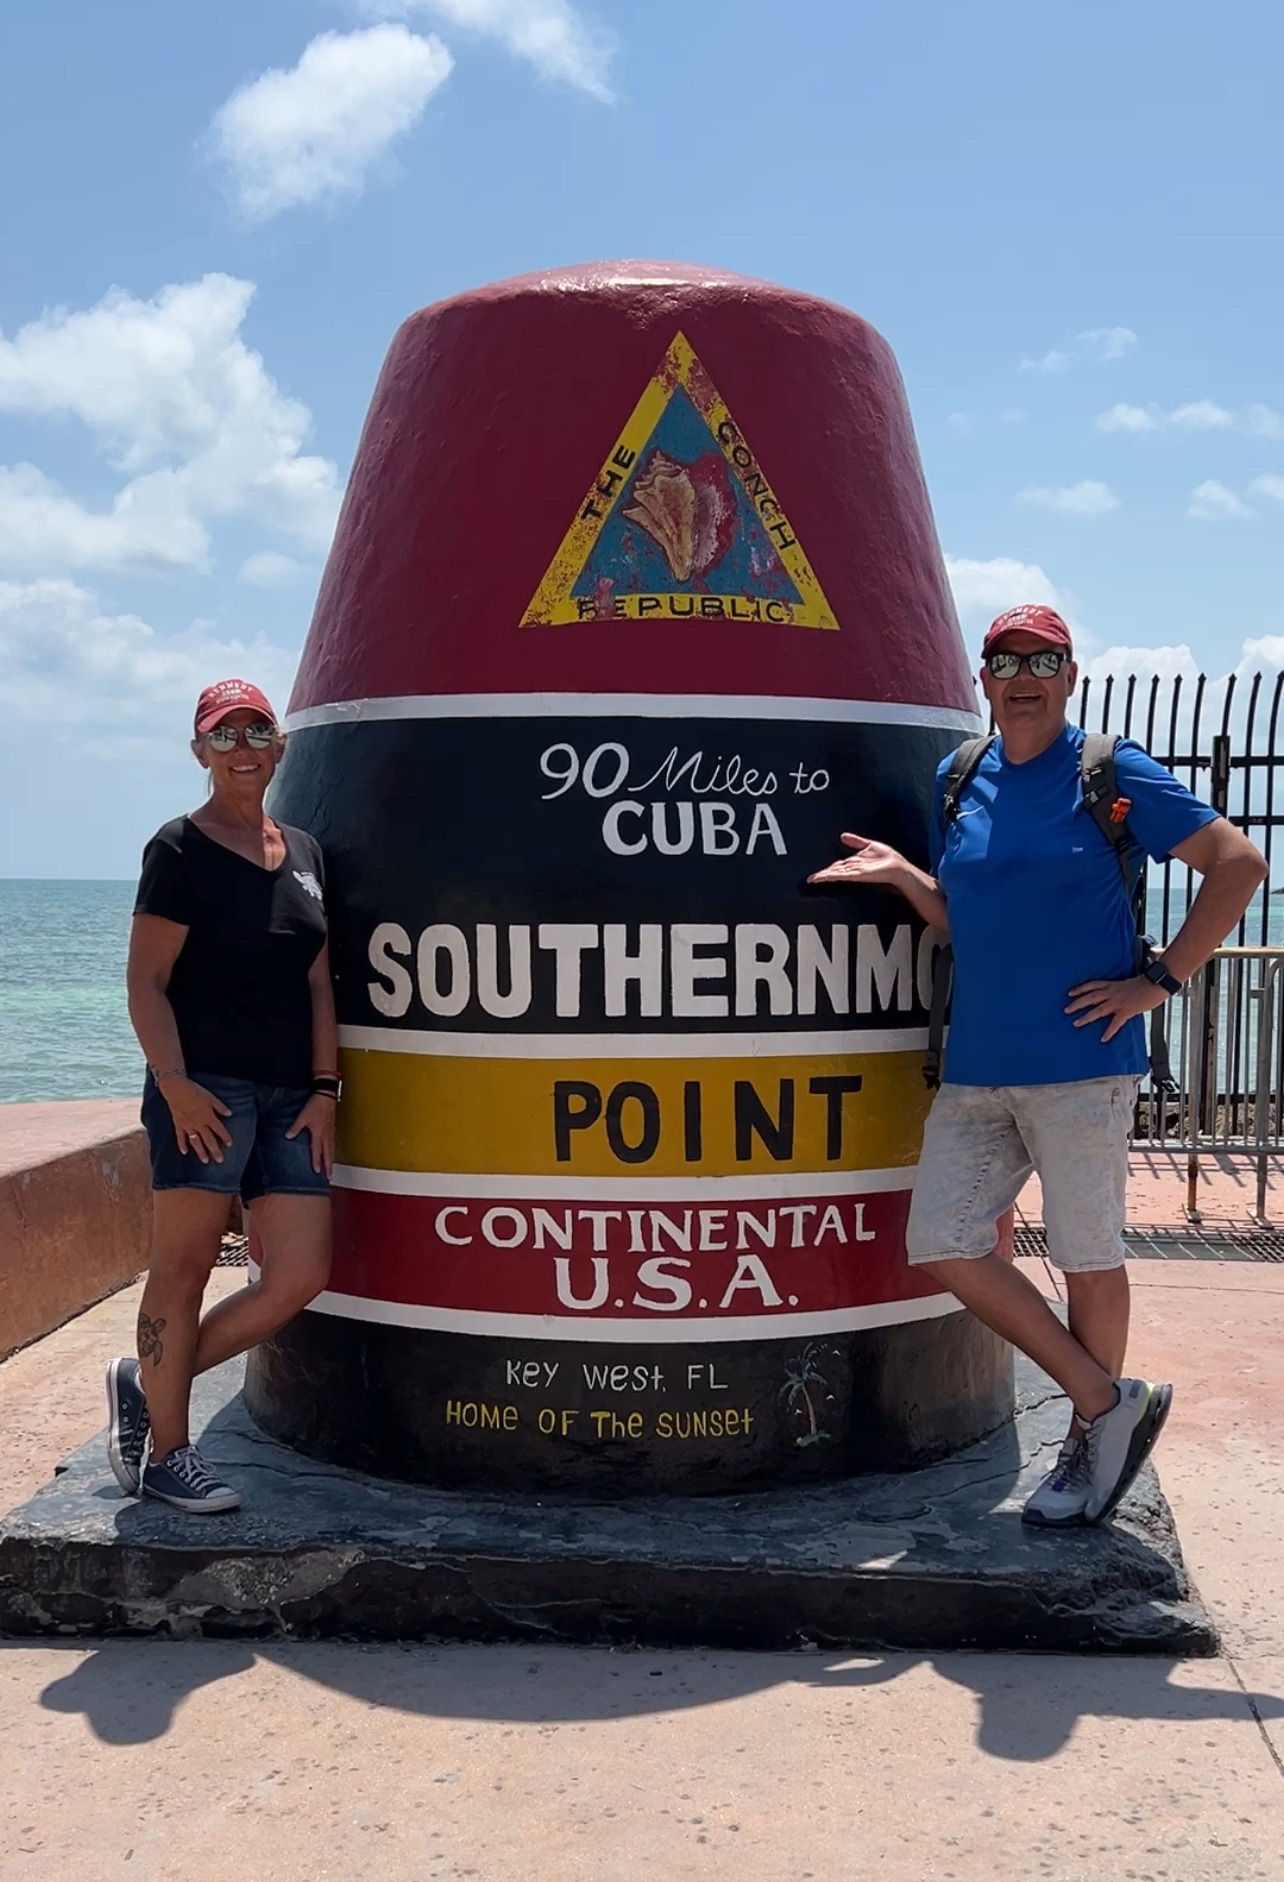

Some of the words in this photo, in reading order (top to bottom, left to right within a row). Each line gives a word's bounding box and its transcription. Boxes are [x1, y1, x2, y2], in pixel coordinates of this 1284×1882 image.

[580, 444, 636, 521] THE
[717, 421, 796, 550] CONCH
[577, 596, 785, 622] REPUBLIC
[540, 743, 630, 799] 90
[628, 747, 778, 795] Miles
[789, 762, 830, 793] to
[602, 800, 787, 855] CUBA
[554, 1075, 862, 1163] POINT
[435, 1203, 876, 1253] CONTINENTAL
[555, 1254, 799, 1311] U.S.A.
[506, 1360, 560, 1388] Key
[688, 1364, 728, 1389] FL
[539, 1409, 579, 1435] OF
